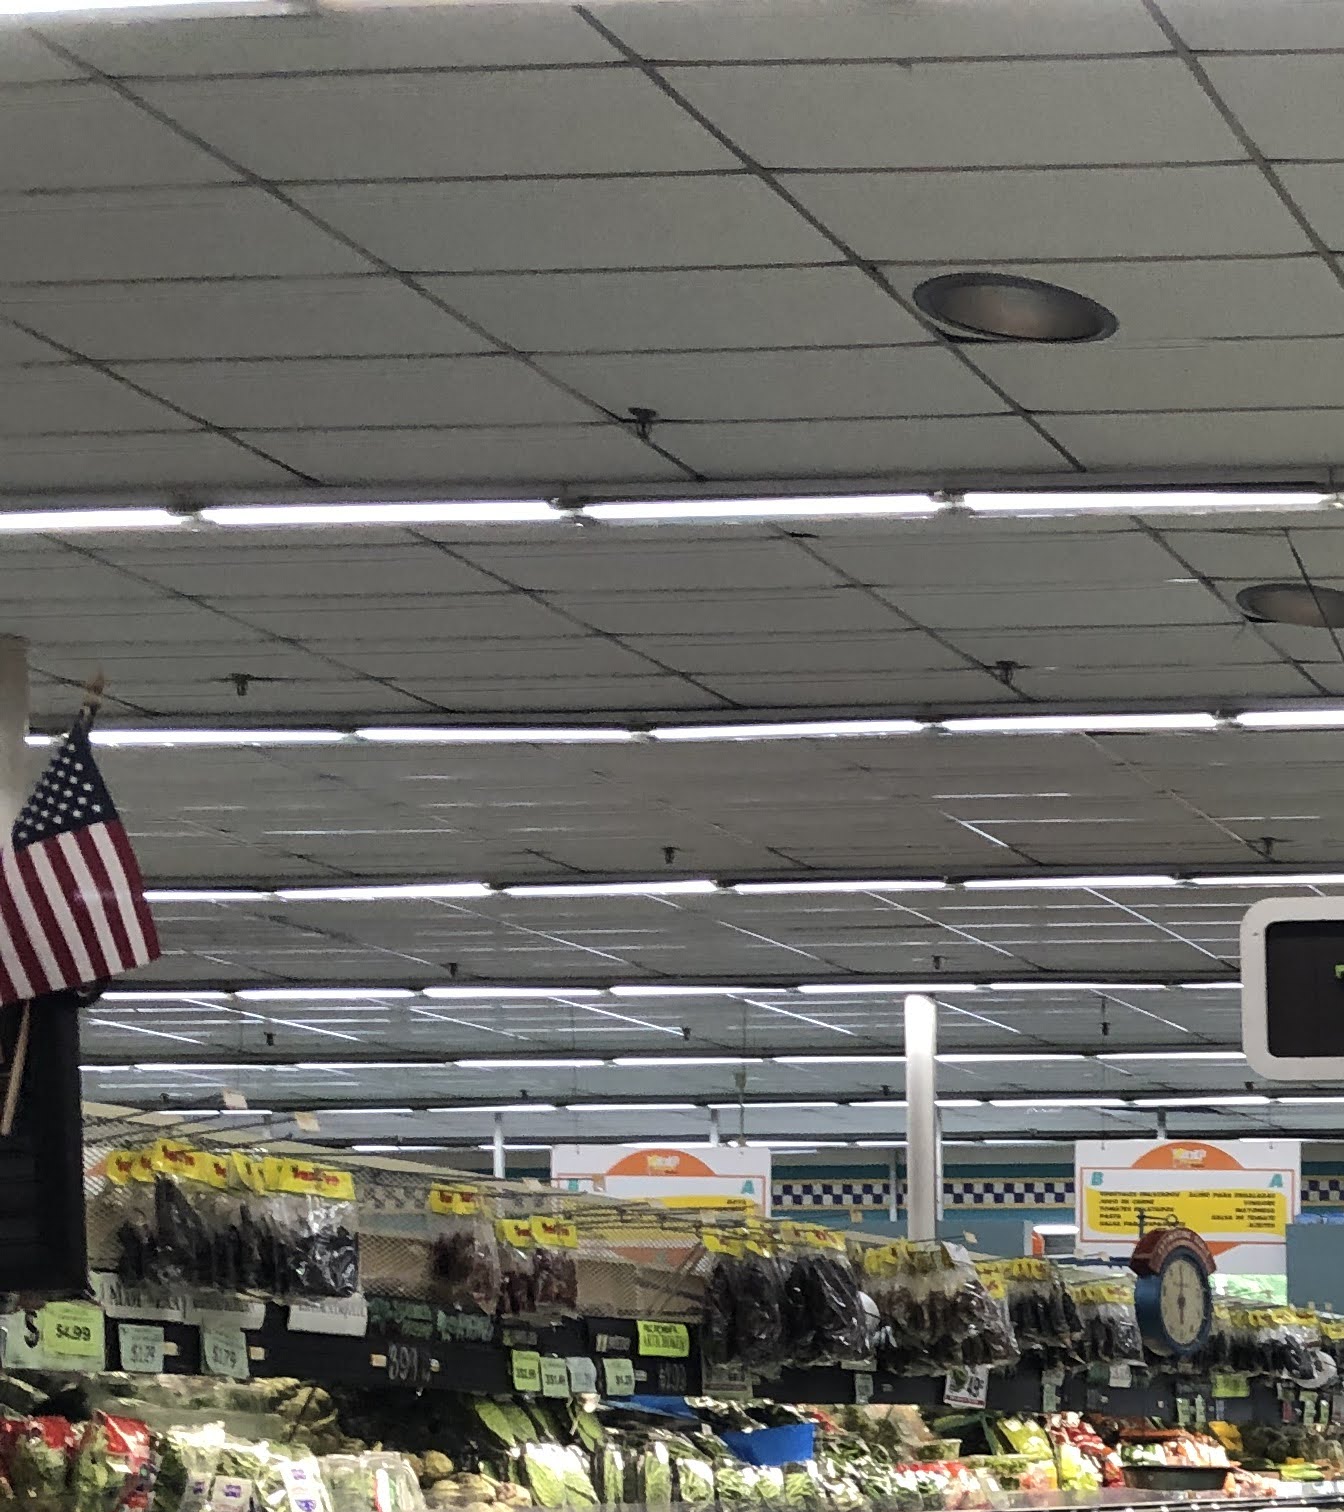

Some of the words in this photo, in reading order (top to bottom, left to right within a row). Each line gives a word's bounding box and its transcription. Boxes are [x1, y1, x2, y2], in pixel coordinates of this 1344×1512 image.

[1090, 1171, 1104, 1186] B
[1268, 1173, 1284, 1188] A
[741, 1179, 755, 1195] A
